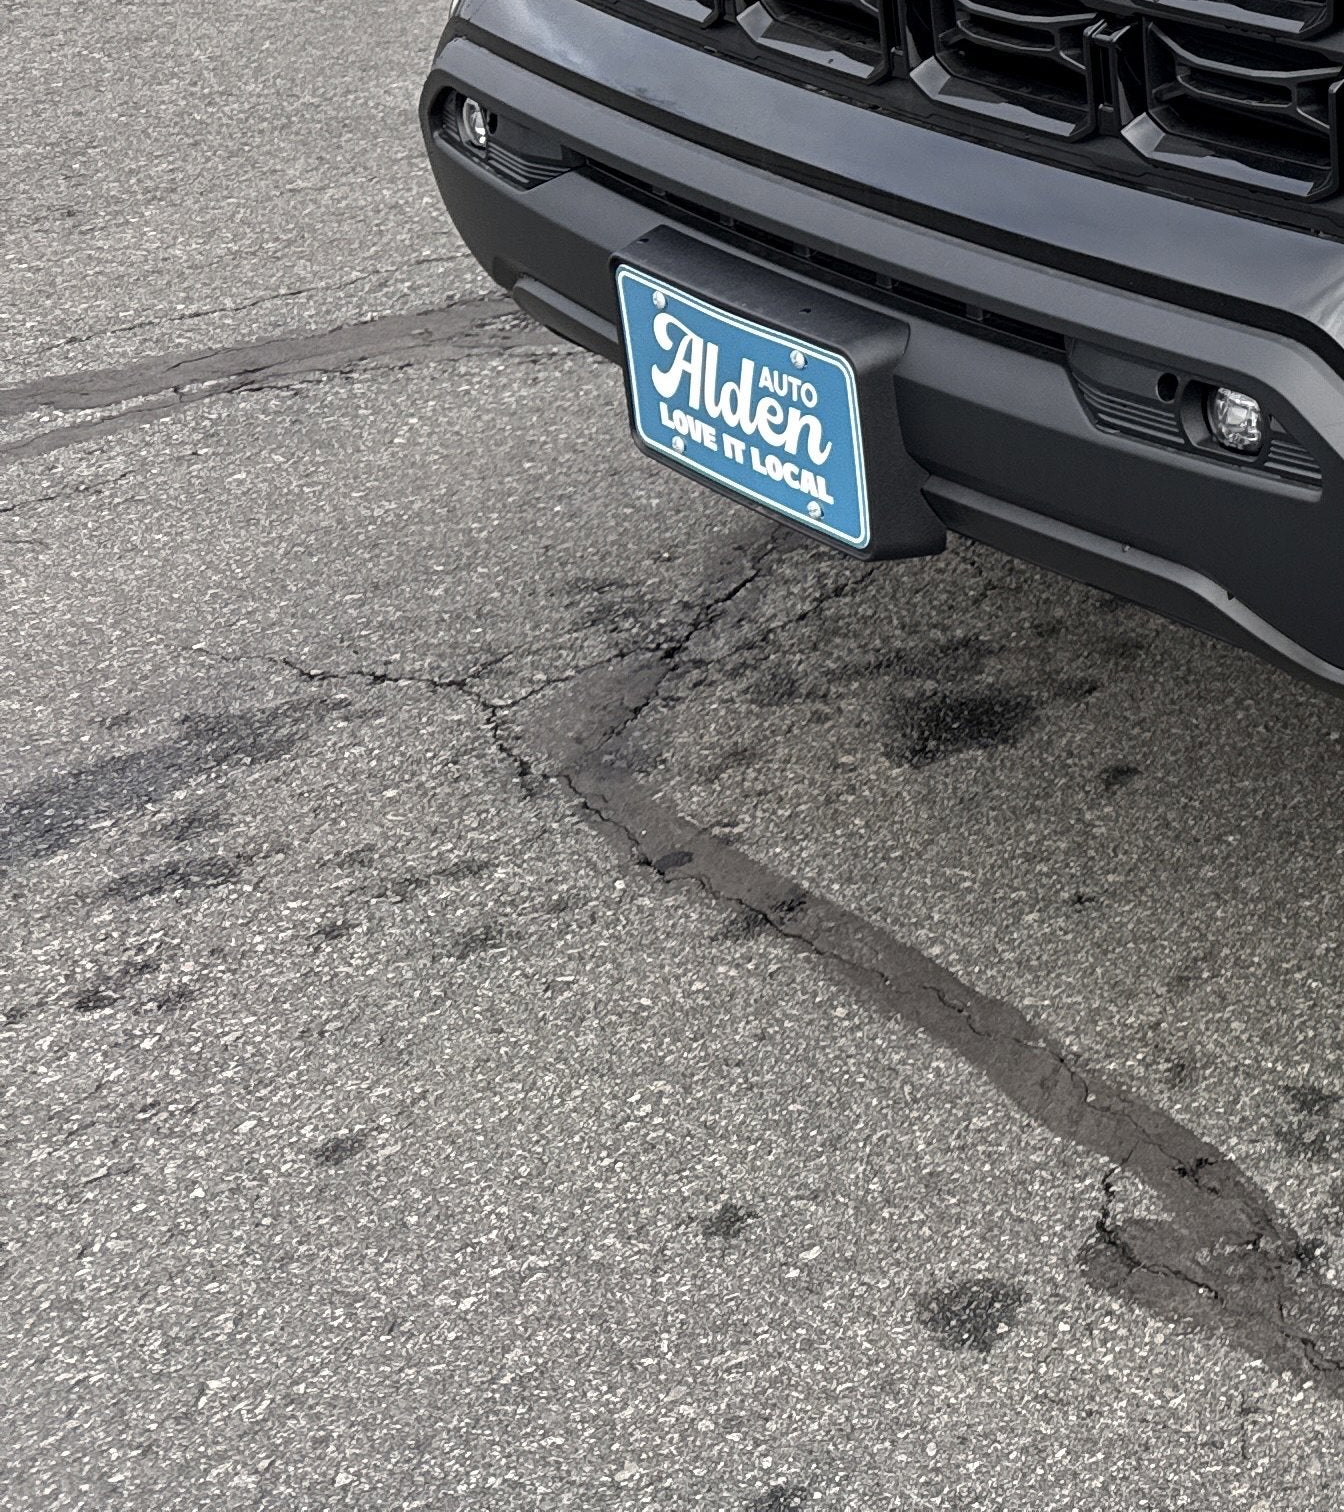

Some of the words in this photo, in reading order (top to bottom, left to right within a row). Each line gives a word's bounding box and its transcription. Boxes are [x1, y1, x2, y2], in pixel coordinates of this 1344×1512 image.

[651, 312, 833, 466] Alden
[758, 366, 818, 409] AUTO
[659, 401, 718, 452] LOVE
[722, 433, 746, 465] IT
[750, 446, 835, 505] LOCAL
